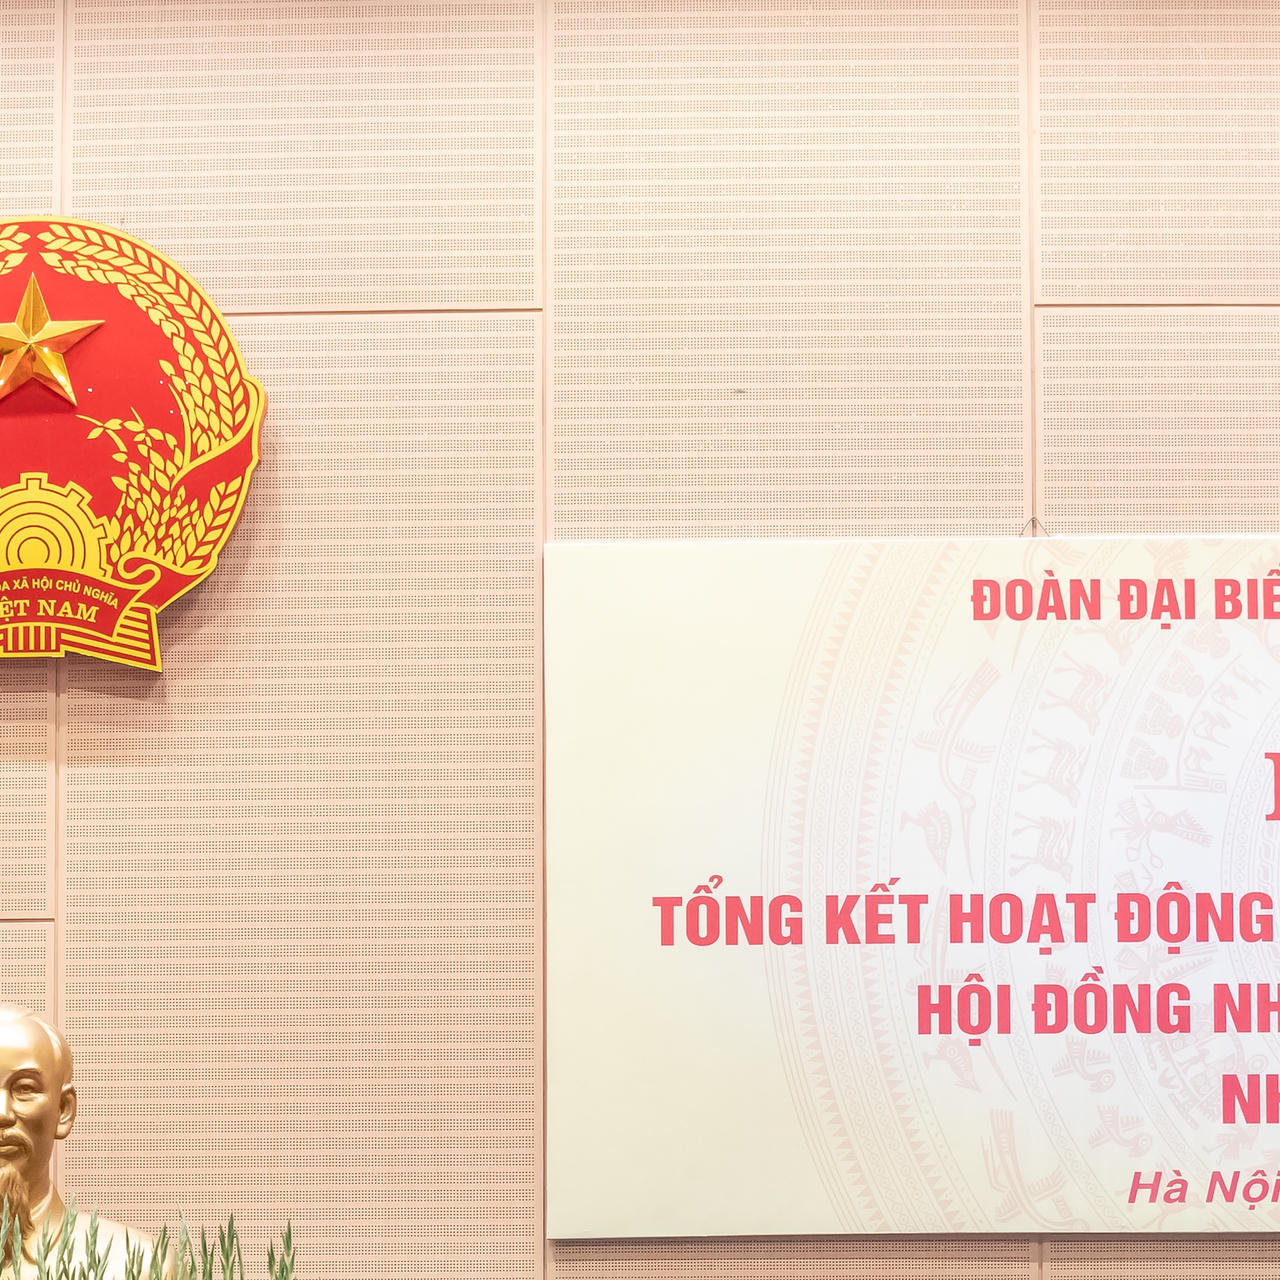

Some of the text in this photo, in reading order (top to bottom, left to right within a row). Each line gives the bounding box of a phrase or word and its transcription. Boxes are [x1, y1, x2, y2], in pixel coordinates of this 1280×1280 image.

[13, 576, 29, 590] XÃ
[32, 576, 52, 591] HỘI
[56, 578, 80, 593] CHỦ
[83, 586, 119, 609] NGHĨA
[37, 600, 99, 623] NAM
[971, 570, 1100, 620] ĐOÀN
[1118, 579, 1195, 629] ĐẠI
[653, 875, 802, 946] TỔNG
[826, 878, 928, 944] KẾT
[950, 894, 1096, 954] HOẠT
[1115, 882, 1273, 954] ĐỘNG
[918, 974, 1010, 1046] HỘI
[1032, 966, 1190, 1034] ĐỒNG
[1128, 1170, 1187, 1203] Hà
